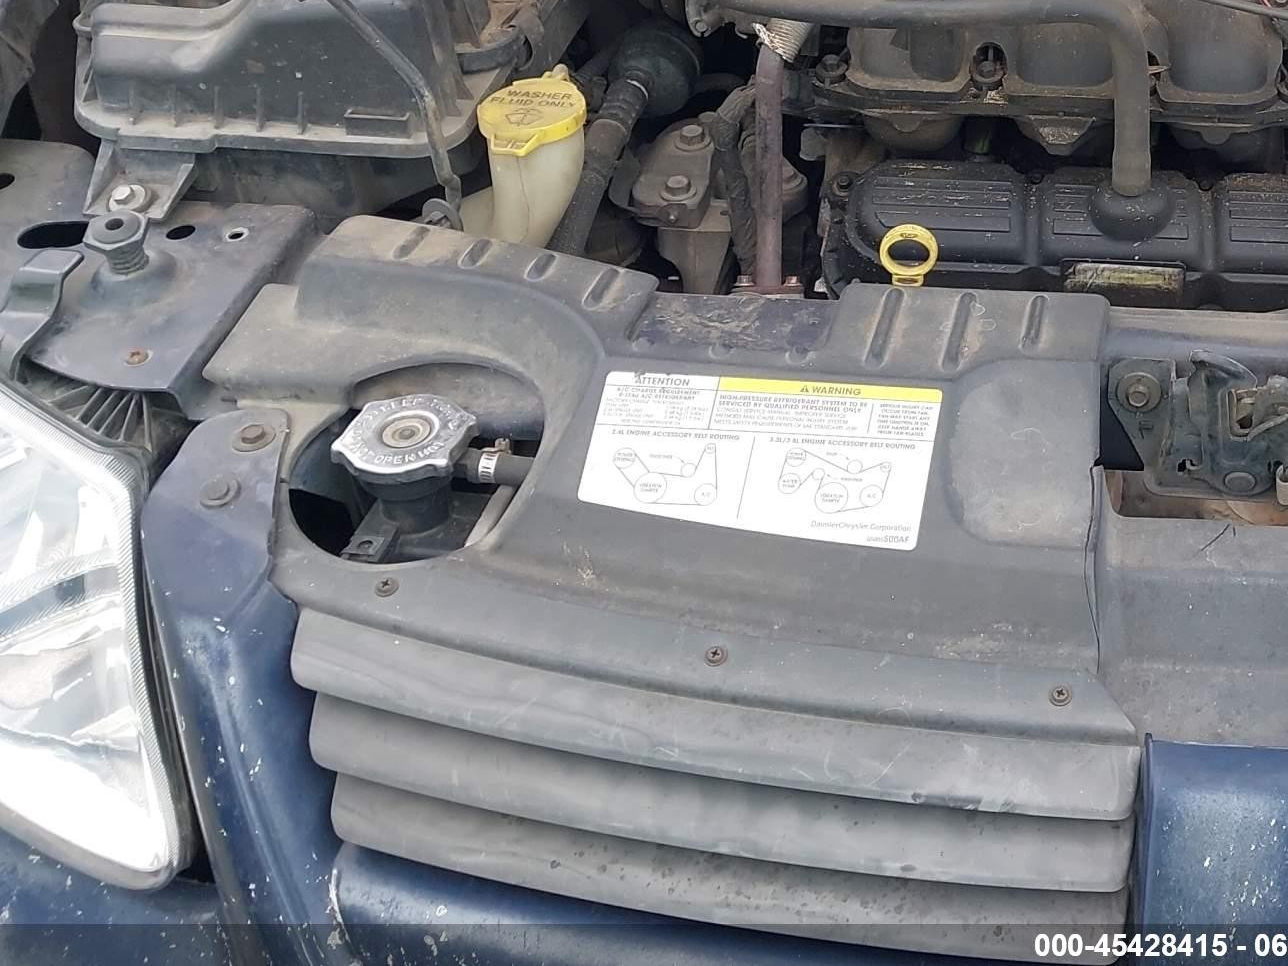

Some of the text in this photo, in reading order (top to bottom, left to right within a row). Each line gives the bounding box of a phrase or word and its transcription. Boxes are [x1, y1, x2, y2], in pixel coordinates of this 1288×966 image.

[507, 89, 573, 101] WASHER
[489, 97, 576, 108] FLUID ONLY
[635, 376, 690, 387] ATTENTION
[811, 385, 862, 397] WARNING
[718, 400, 752, 409] SERVICED
[763, 403, 799, 412] QUALIFIED
[800, 404, 842, 413] PERSONNEL
[822, 399, 848, 407] SYSTEM
[626, 429, 651, 437] ENGINE
[652, 431, 692, 439] ACCESSORY
[709, 433, 741, 441] ROUTING
[801, 437, 827, 446] ENGINE
[828, 439, 869, 448] ACCESSORY
[885, 442, 916, 450] ROUTING
[869, 522, 912, 532] Corporation
